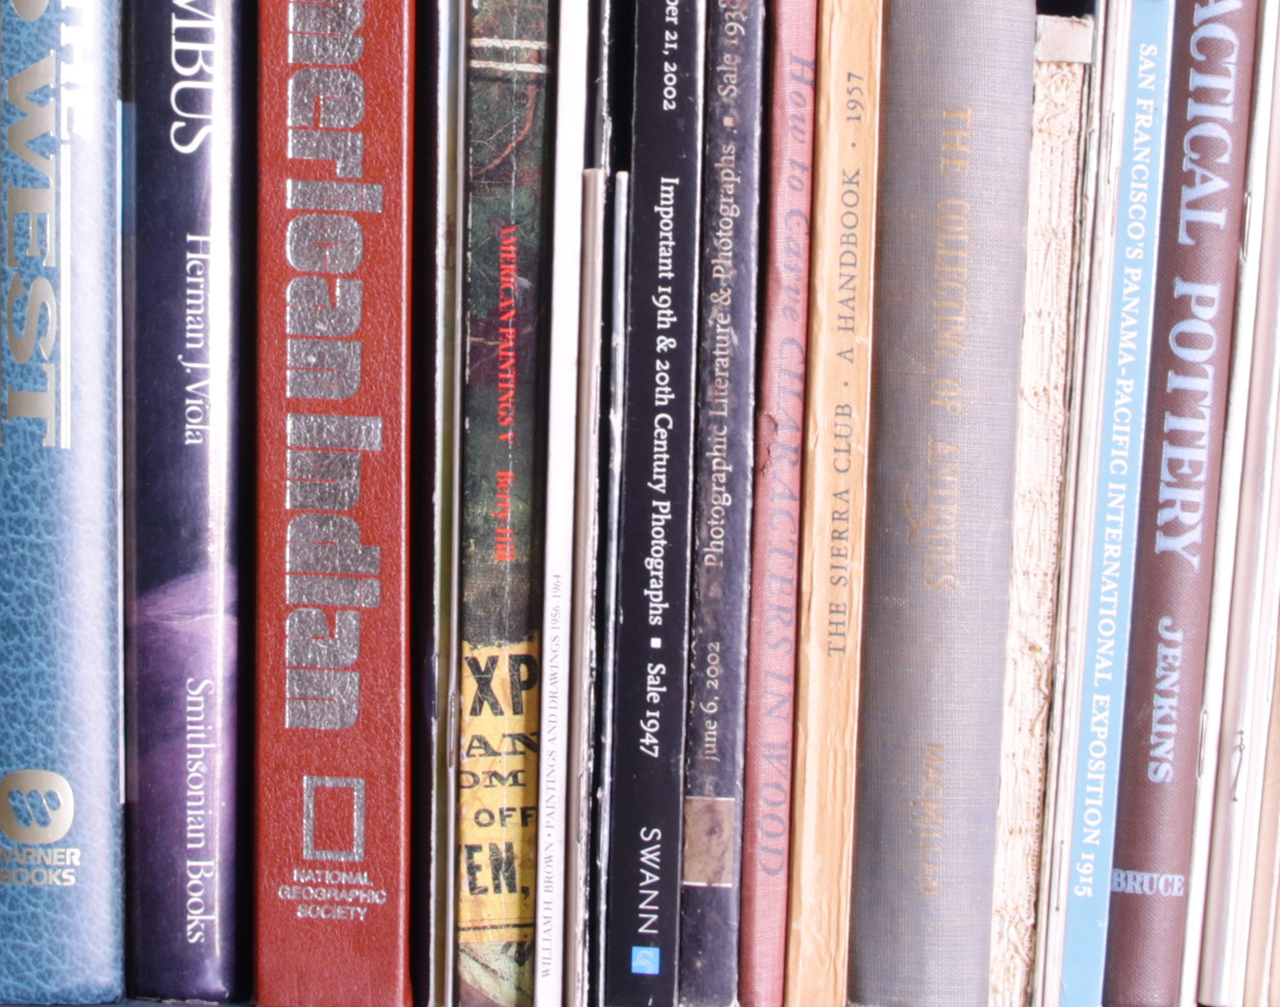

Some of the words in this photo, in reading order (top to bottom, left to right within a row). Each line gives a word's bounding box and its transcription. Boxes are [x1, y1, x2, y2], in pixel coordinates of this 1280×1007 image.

[664, 30, 678, 55] 21,
[716, 54, 739, 97] Sale
[1138, 43, 1158, 91] SAN
[663, 63, 677, 110] 2002
[788, 53, 815, 145] How
[847, 72, 864, 121] 1957
[787, 158, 804, 192] to
[940, 105, 973, 176] THE
[712, 143, 740, 279] Photographs
[1125, 97, 1153, 260] FRANCISCO'S
[6, 47, 57, 447] WEST
[655, 176, 679, 287] Important
[837, 167, 861, 333] HANDBOOK
[185, 233, 213, 352] Herman
[499, 225, 518, 321] AMERICAN
[652, 287, 676, 329] 19th
[710, 284, 731, 305] &
[932, 199, 970, 357] COLLECTING
[178, 354, 211, 375] J.
[497, 327, 516, 426] PAINTINGS
[657, 335, 676, 351] &
[708, 313, 730, 417] Literature
[837, 346, 854, 363] A
[1109, 266, 1142, 475] PANAMA-PACIFIC
[184, 381, 213, 445] Viola
[655, 359, 675, 406] 20th
[931, 379, 961, 416] OF
[647, 414, 672, 493] Century
[833, 402, 851, 474] CLUB
[1155, 277, 1220, 574] POTTERY
[704, 423, 731, 568] Photographic
[286, 412, 383, 729] Indian
[645, 500, 670, 626] Photographs
[831, 486, 850, 588] SIERRA
[1094, 481, 1127, 687] INTERNATIONAL
[827, 599, 846, 657] THE
[548, 634, 560, 708] DRAWINGS
[647, 663, 666, 704] Sale
[706, 641, 720, 688] 2002
[762, 670, 792, 721] IN
[1148, 616, 1184, 784] JENKINS
[185, 677, 216, 851] Smithsonian
[547, 713, 558, 744] AND
[639, 709, 660, 757] 1947
[545, 751, 557, 830] PAINTINGS
[1084, 693, 1111, 846] EXPOSITION
[759, 740, 788, 877] WOOD
[0, 868, 76, 887] BOOKS
[185, 859, 215, 945] Books
[278, 885, 387, 904] GEOGRAPHIC
[293, 869, 374, 886] NATIONAL
[544, 842, 554, 893] BROWN
[639, 827, 661, 933] SWANN
[1074, 851, 1095, 897] 1915
[1111, 868, 1185, 897] BRUCE
[296, 903, 368, 921] SOCIETY
[541, 909, 553, 978] WILLIAM
